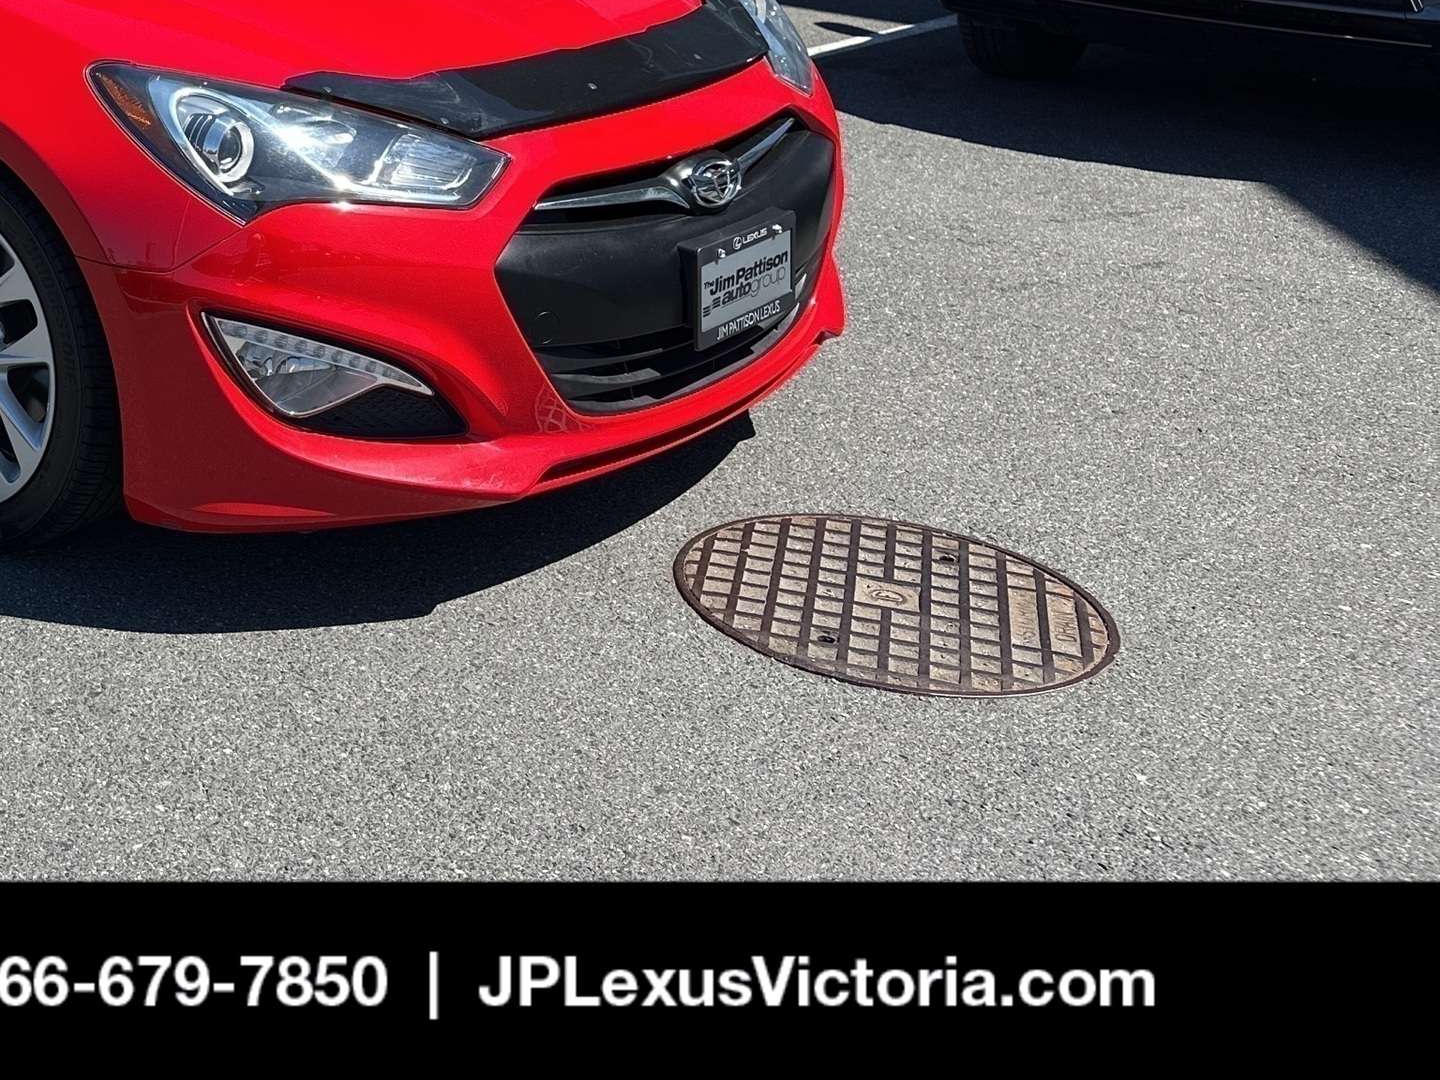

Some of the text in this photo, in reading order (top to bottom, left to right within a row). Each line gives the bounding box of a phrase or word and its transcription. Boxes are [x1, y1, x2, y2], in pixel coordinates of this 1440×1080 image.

[743, 228, 768, 244] LEXUS
[710, 275, 735, 296] Jim
[735, 250, 789, 285] Pattison
[716, 300, 781, 340] JIM PATTISON LEXUS
